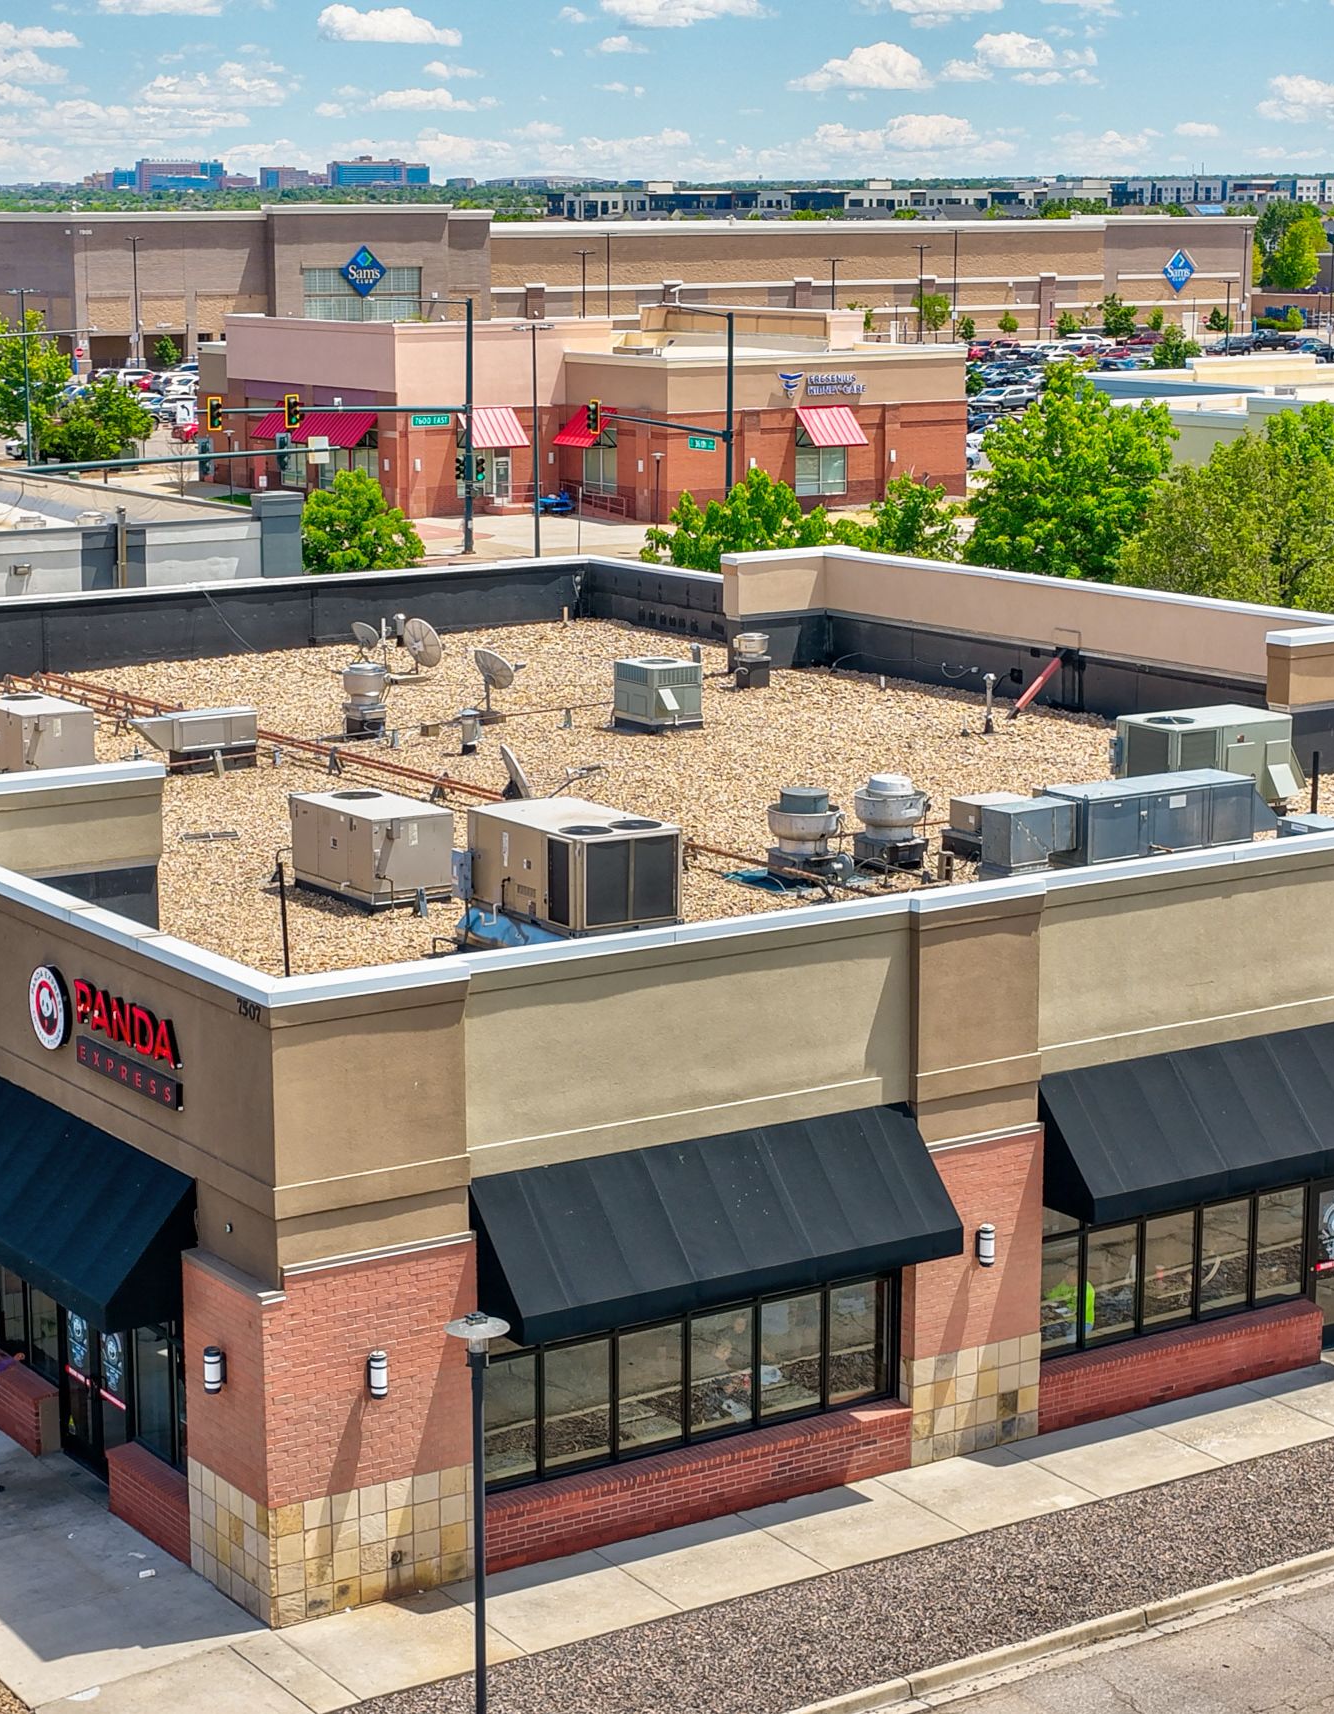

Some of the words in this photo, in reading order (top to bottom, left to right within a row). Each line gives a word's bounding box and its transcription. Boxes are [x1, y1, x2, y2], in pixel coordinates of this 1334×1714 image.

[348, 264, 381, 280] Sam's
[1167, 264, 1191, 278] Sam's
[808, 374, 857, 384] FRESENIUS
[808, 385, 841, 395] KIDNEY
[842, 384, 868, 394] CARE
[433, 416, 448, 425] EAST
[236, 997, 261, 1023] 7507
[74, 978, 176, 1070] PANDA
[78, 1046, 171, 1102] EXPRESS
